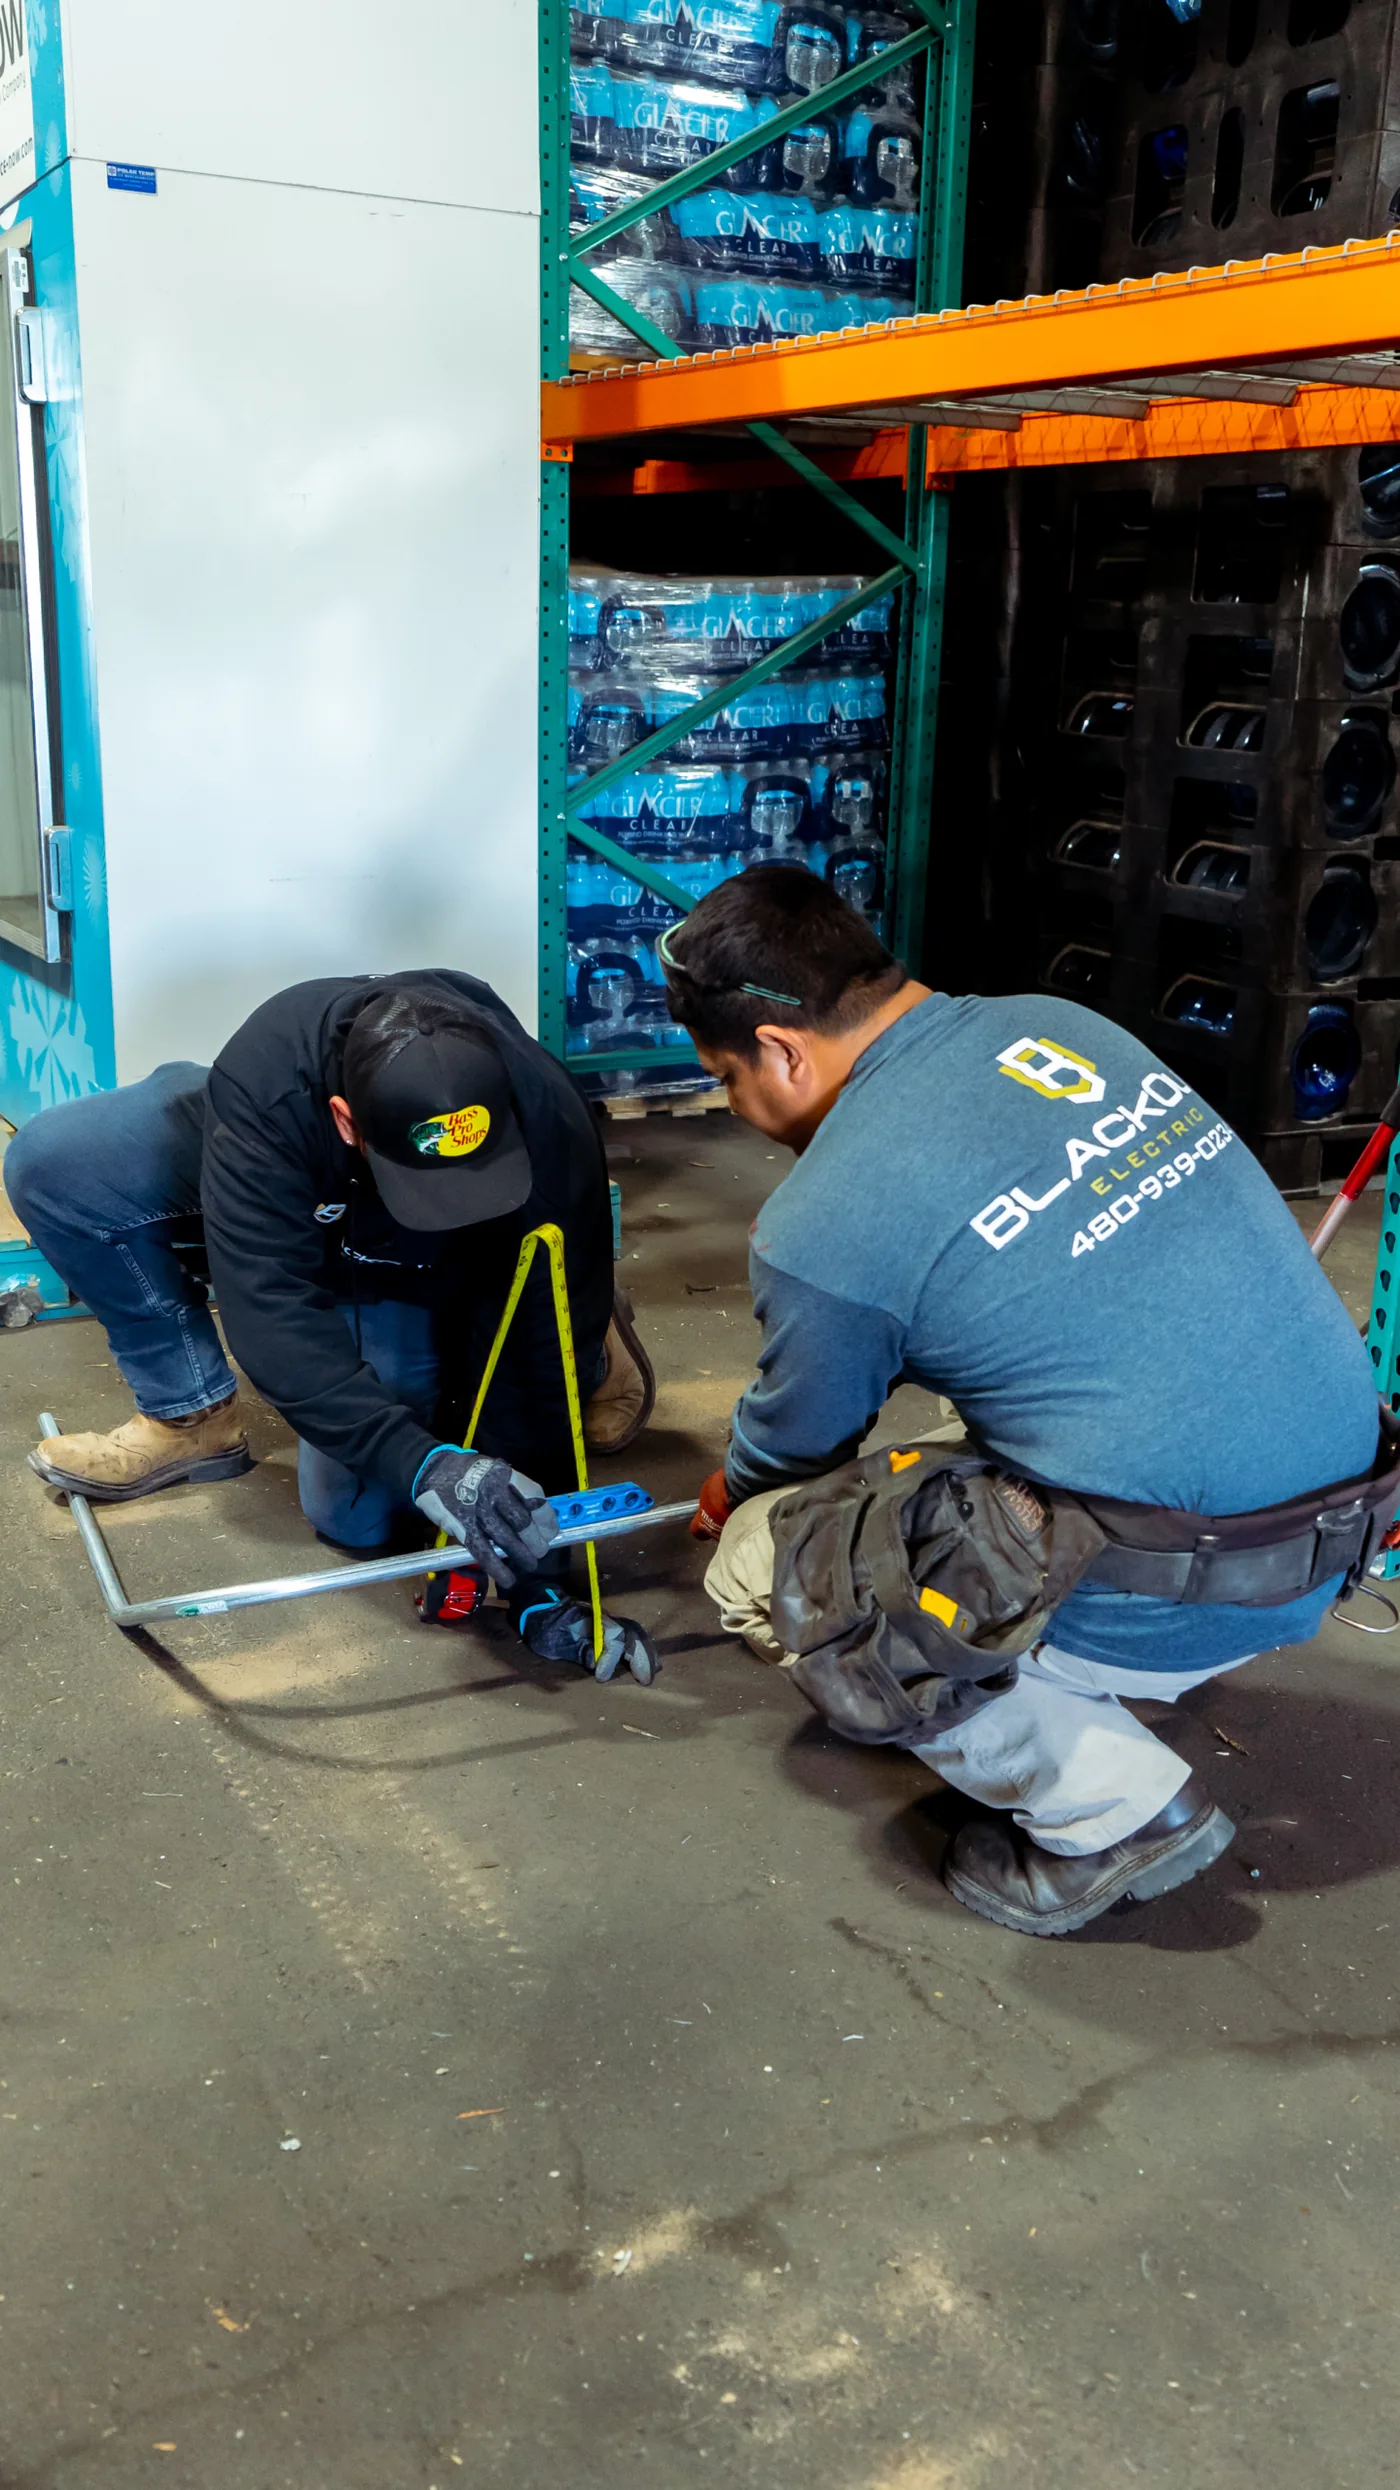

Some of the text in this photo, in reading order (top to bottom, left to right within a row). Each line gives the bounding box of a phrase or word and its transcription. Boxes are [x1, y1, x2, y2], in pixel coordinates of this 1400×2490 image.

[706, 729, 759, 743] CLEAR
[448, 1108, 478, 1126] Bass
[450, 1127, 487, 1148] Shops
[451, 1122, 473, 1137] Pro
[1089, 1107, 1204, 1196] ELECTRIC
[1071, 1122, 1234, 1258] 480-939-023
